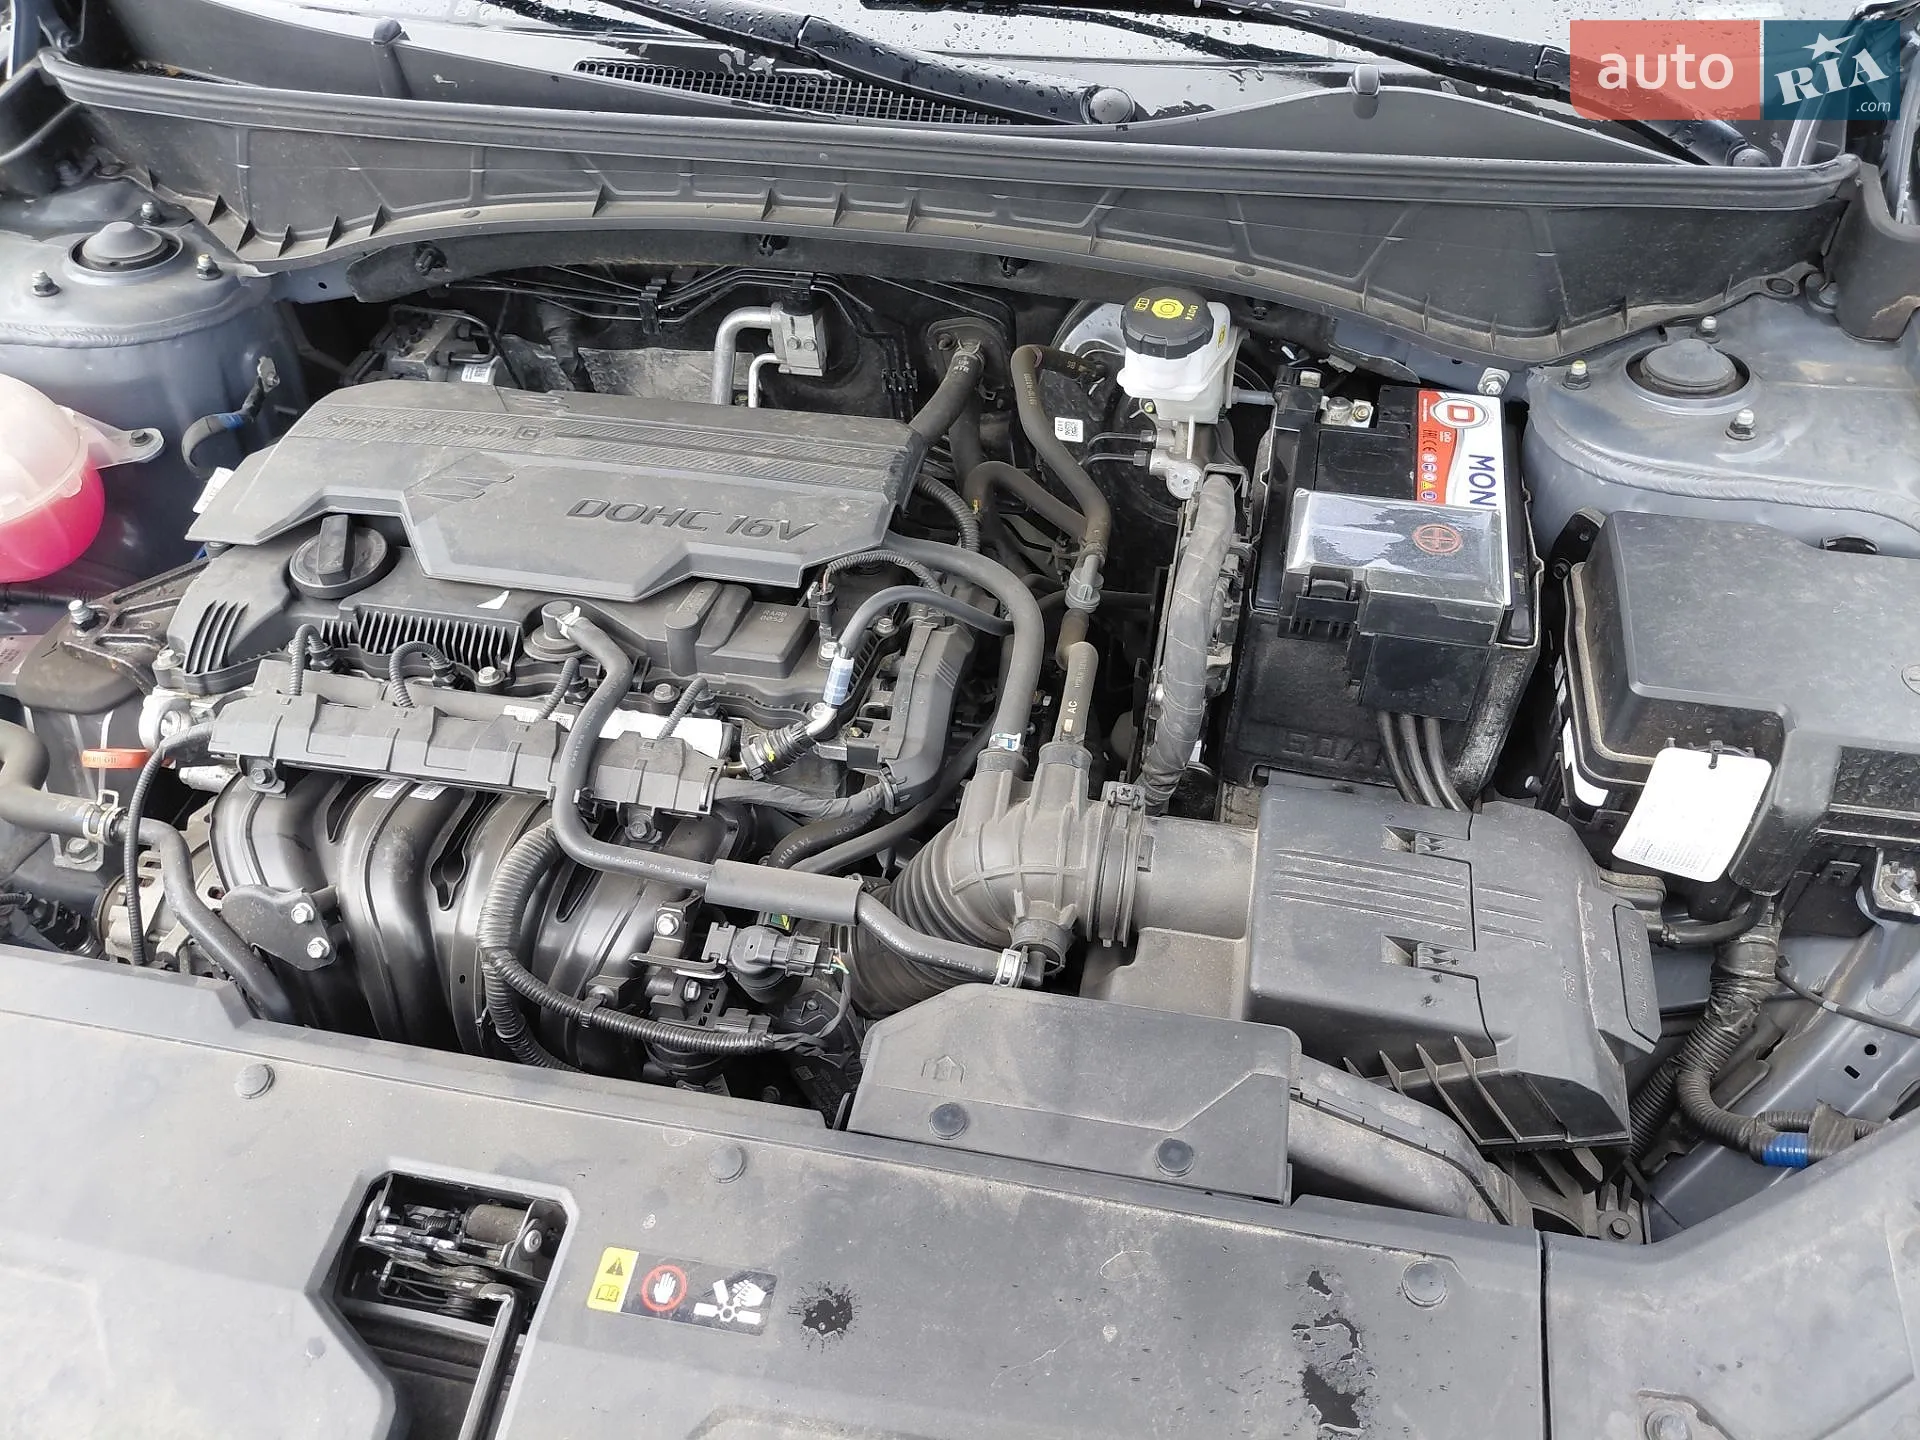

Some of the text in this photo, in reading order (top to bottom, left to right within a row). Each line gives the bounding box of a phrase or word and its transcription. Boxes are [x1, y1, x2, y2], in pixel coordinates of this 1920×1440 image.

[566, 496, 819, 542] DOHC 16V
[1067, 700, 1078, 714] AC
